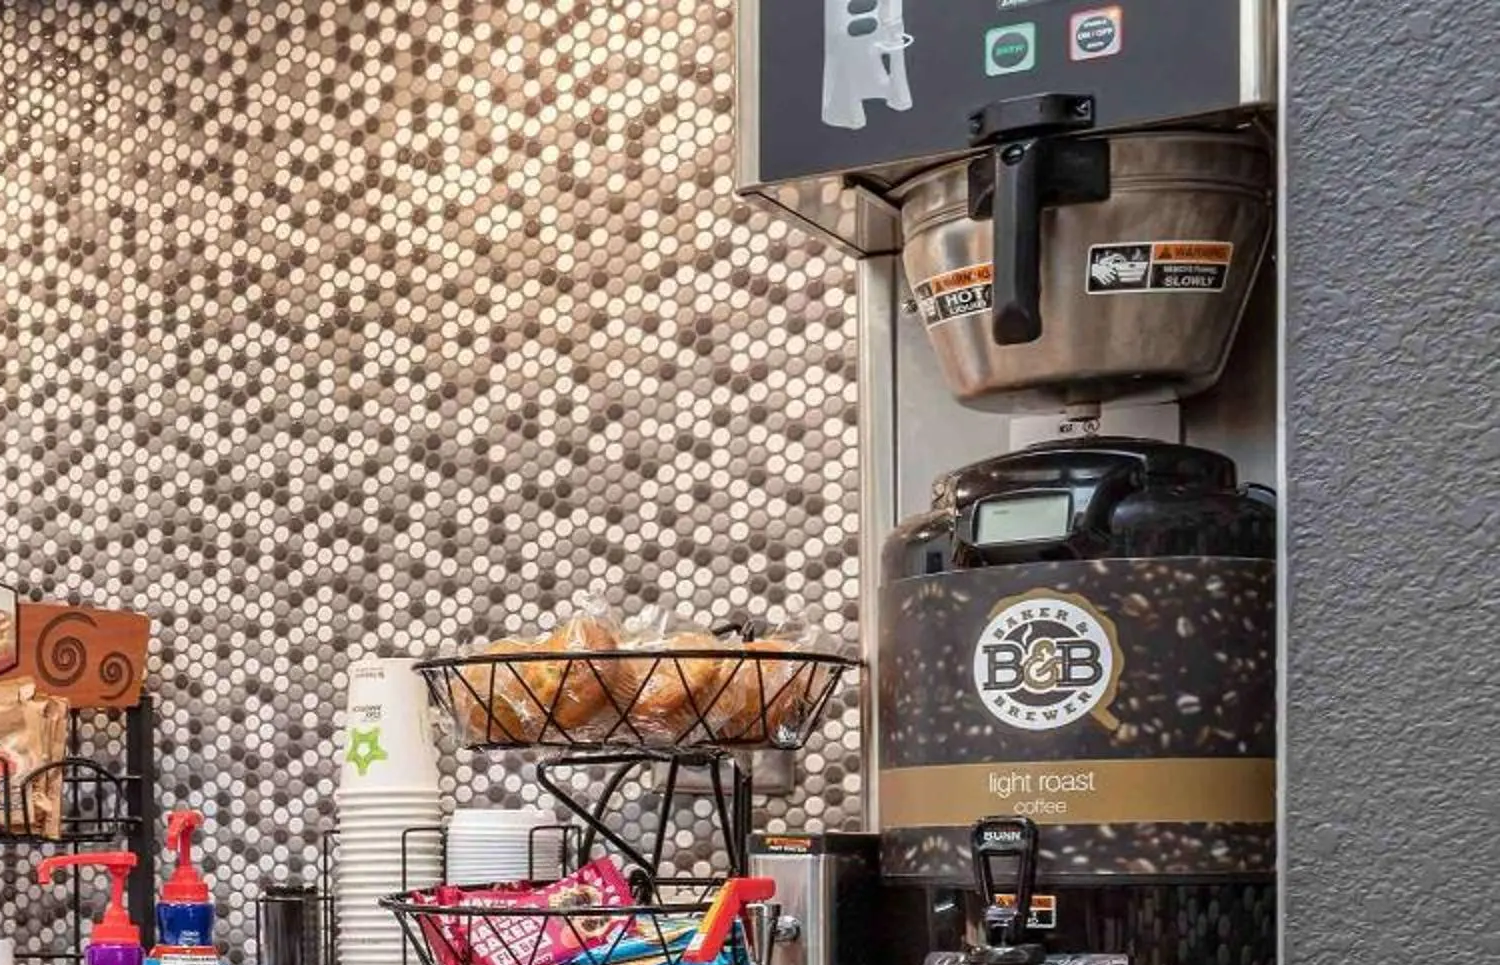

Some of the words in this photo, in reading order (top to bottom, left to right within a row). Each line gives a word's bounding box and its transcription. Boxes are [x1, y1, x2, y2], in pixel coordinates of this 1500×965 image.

[1163, 275, 1216, 288] SLOWLY
[944, 286, 985, 307] HOT
[993, 606, 1070, 640] BAKER
[982, 638, 1103, 691] B&B
[993, 691, 1093, 721] BREWER
[988, 771, 1032, 799] light
[1038, 770, 1097, 793] roast
[1012, 798, 1068, 815] coffee
[983, 830, 1022, 841] BUNN
